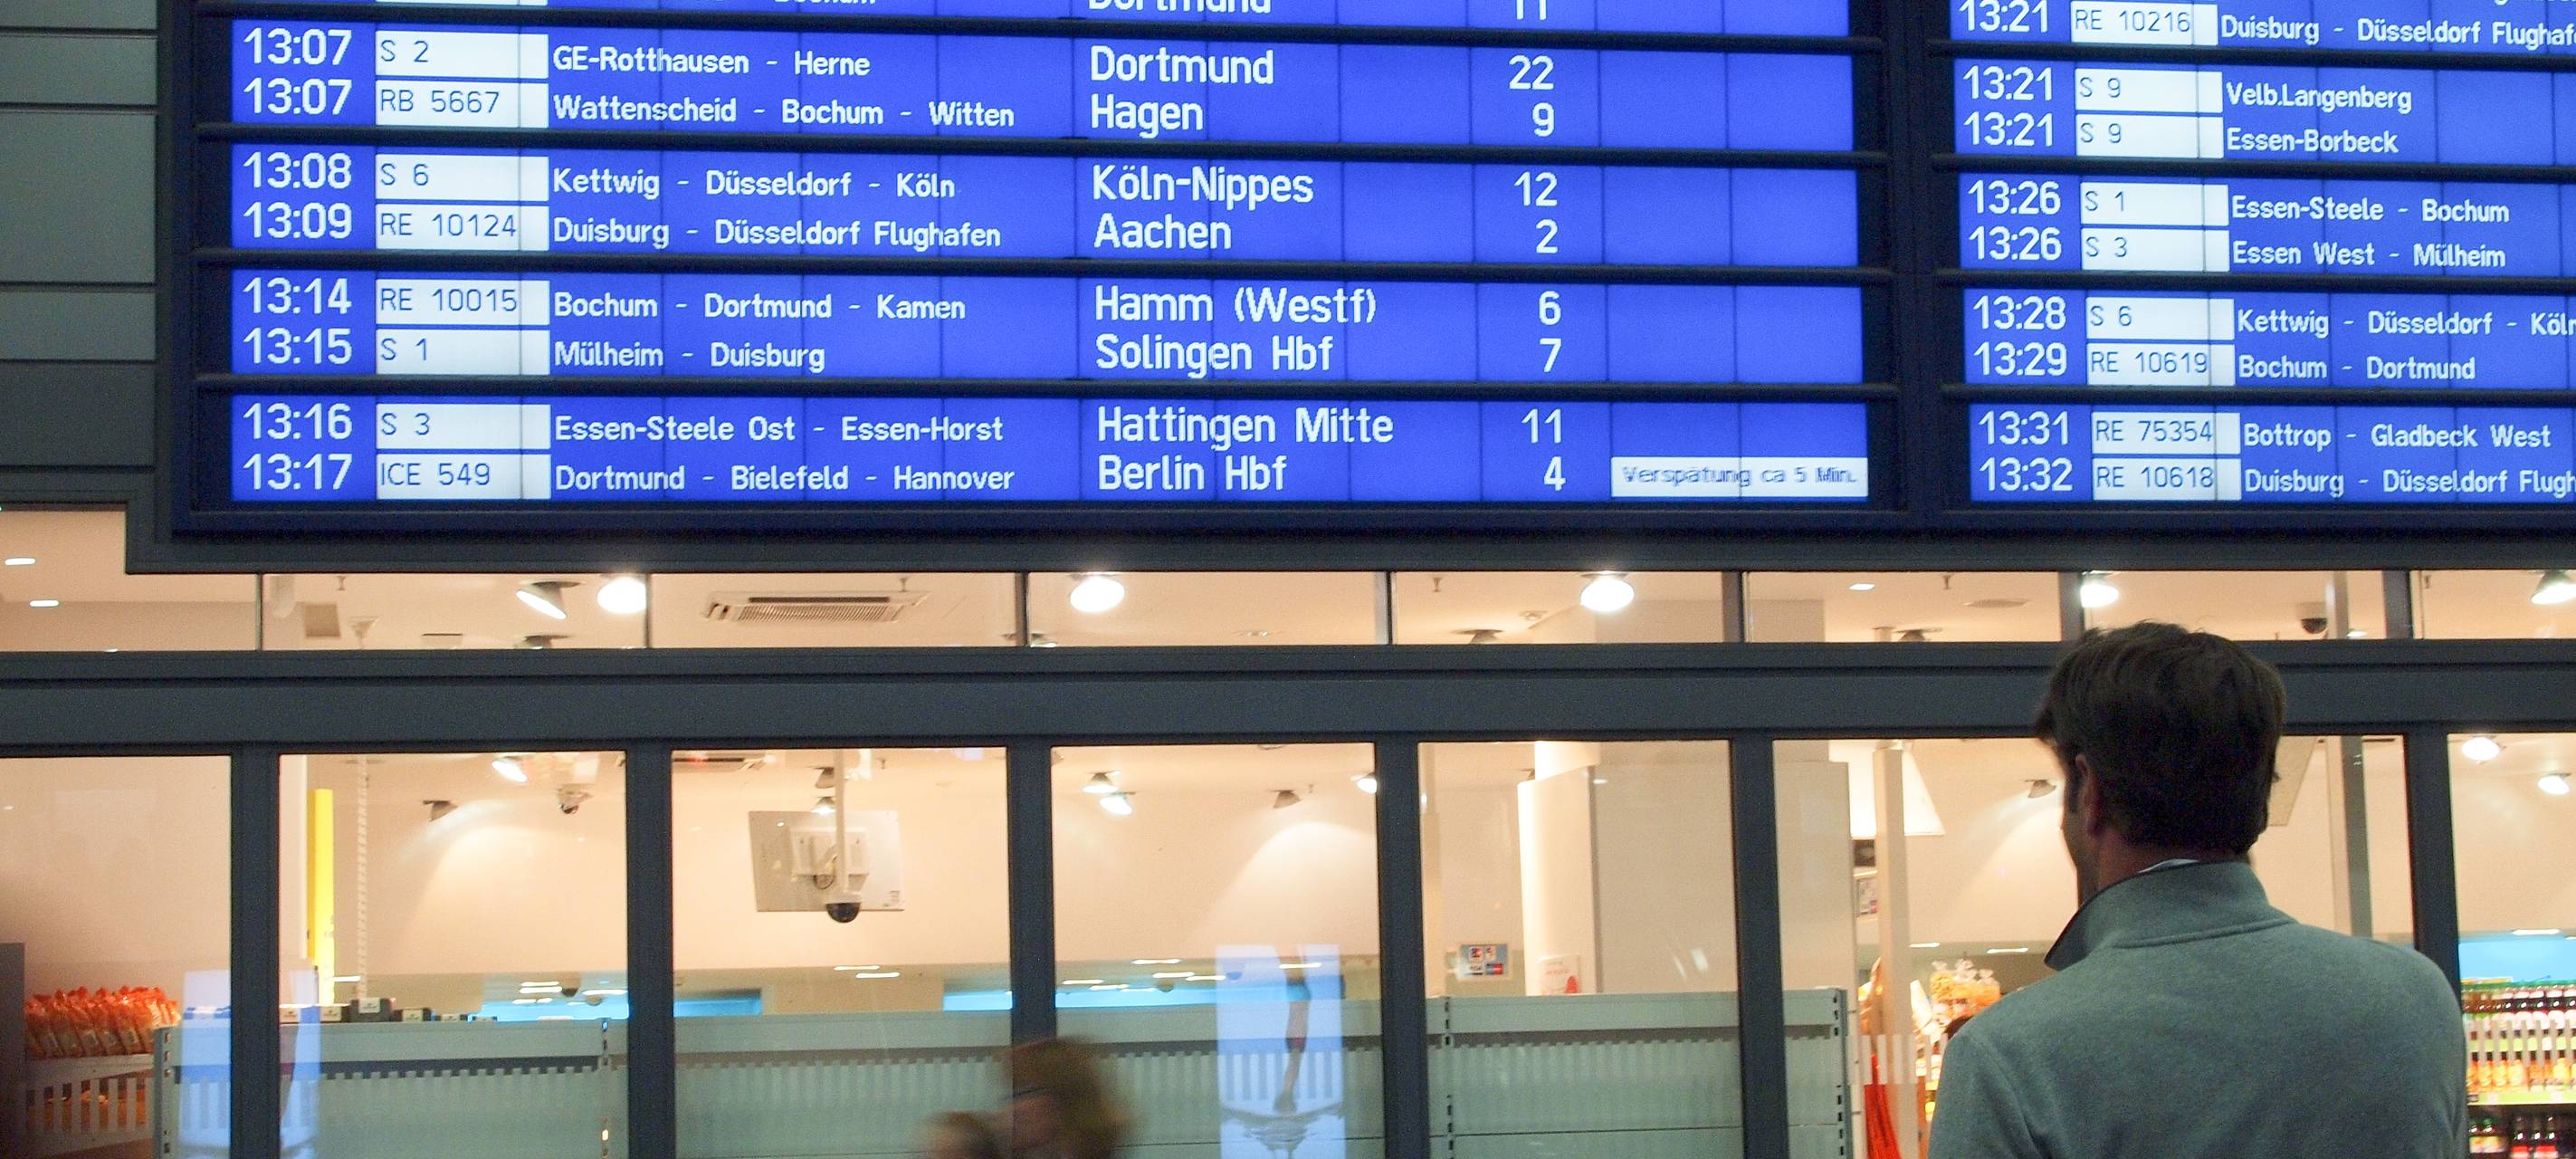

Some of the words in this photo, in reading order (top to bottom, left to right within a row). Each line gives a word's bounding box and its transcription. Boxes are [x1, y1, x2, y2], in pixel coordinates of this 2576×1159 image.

[1960, 0, 2047, 32] 13:21
[2076, 9, 2102, 30] RE
[2120, 11, 2190, 32] 10216
[2222, 14, 2319, 44] Duisburg
[2358, 18, 2480, 43] Düsseldorf
[2493, 22, 2576, 50] Flughaf
[244, 28, 351, 64] 13:07
[381, 40, 395, 62] S
[414, 41, 428, 62] 2
[554, 46, 749, 73] GE-Rotthausen
[796, 51, 870, 75] Herne
[1092, 46, 1273, 83] Dortmund
[1510, 55, 1553, 90] 22
[244, 78, 351, 114] 13:07
[1963, 66, 2051, 101] 13:21
[2080, 77, 2093, 97] S
[2108, 78, 2121, 98] 9
[2227, 82, 2411, 114] Velb.Langenberg
[381, 89, 413, 111] RB
[432, 91, 499, 113] 5667
[554, 95, 736, 121] Wattenscheid
[783, 99, 883, 124] Bochum
[929, 101, 1014, 126] Witten
[1092, 94, 1202, 139] Hagen
[1533, 103, 1554, 136] 9
[1964, 111, 2052, 146] 13:21
[2081, 123, 2093, 143] S
[2109, 123, 2121, 143] 9
[2228, 128, 2399, 152] Essen-Borbeck
[244, 152, 351, 188] 13:08
[381, 163, 396, 186] S
[414, 164, 428, 186] 6
[554, 168, 659, 199] Kettwig
[707, 170, 851, 196] Düsseldorf
[898, 173, 954, 197] Köln
[1093, 165, 1313, 210] Köln-Nippes
[1515, 172, 1557, 206] 12
[1969, 180, 2060, 214] 13:26
[2085, 191, 2098, 211] S
[2115, 191, 2123, 211] 1
[243, 202, 351, 238] 13:09
[381, 213, 412, 235] RE
[433, 214, 516, 236] 10124
[2233, 196, 2383, 220] Essen-Steele
[2423, 199, 2509, 222] Bochum
[554, 217, 669, 248] Duisburg
[716, 219, 860, 244] Düsseldorf
[875, 221, 1000, 252] Flughafen
[1094, 214, 1231, 248] Aachen
[1536, 219, 1558, 253] 2
[1970, 226, 2061, 260] 13:26
[2086, 236, 2099, 257] S
[2114, 237, 2126, 257] 3
[2234, 241, 2301, 263] Essen
[2314, 242, 2374, 264] West
[2414, 244, 2505, 266] Mülheim
[243, 278, 351, 313] 13:14
[380, 288, 413, 311] RE
[433, 289, 517, 311] 10015
[555, 292, 657, 316] Bochum
[705, 293, 831, 318] Dortmund
[878, 294, 965, 319] Kamen
[1096, 285, 1212, 321] Hamm
[1235, 287, 1376, 322] (Westf)
[1540, 292, 1560, 325] 6
[1974, 296, 2066, 330] 13:28
[2091, 305, 2104, 326] S
[2119, 306, 2132, 326] 6
[2238, 310, 2328, 338] Kettwig
[2369, 311, 2492, 334] Düsseldorf
[243, 328, 351, 363] 13:15
[381, 338, 396, 360] S
[416, 339, 426, 360] 1
[555, 341, 663, 366] Mülheim
[711, 342, 825, 373] Duisburg
[1096, 334, 1252, 378] Solingen
[1273, 336, 1332, 370] Hbf
[1541, 339, 1560, 372] 7
[1974, 342, 2066, 375] 13:29
[2092, 351, 2119, 372] RE
[2136, 352, 2208, 373] 10619
[2239, 355, 2326, 378] Bochum
[2367, 357, 2475, 378] Dortmund
[244, 404, 351, 439] 13:16
[381, 413, 396, 435] S
[415, 413, 430, 436] 3
[556, 416, 733, 440] Essen-Steele
[749, 417, 795, 440] Ost
[843, 417, 1003, 440] Essen-Horst
[1099, 407, 1275, 451] Hattingen
[1296, 407, 1393, 442] Mitte
[1522, 409, 1560, 443] 11
[1980, 411, 2067, 445] 13:31
[2096, 420, 2123, 441] RE
[2138, 420, 2213, 442] 75354
[2245, 424, 2331, 451] Bottrop
[2371, 425, 2477, 446] Gladbeck
[2491, 425, 2550, 446] West
[243, 454, 351, 489] 13:17
[381, 463, 421, 485] ICE
[438, 463, 490, 485] 549
[557, 465, 684, 489] Dortmund
[732, 465, 848, 489] Bielefeld
[894, 465, 1015, 489] Hannover
[1100, 455, 1204, 489] Berlin
[1226, 455, 1286, 490] Hbf
[1544, 456, 1565, 490] 4
[1761, 469, 1786, 483] ca
[1795, 466, 1807, 483] 5
[1816, 466, 1857, 483] Min.
[1980, 457, 2072, 491] 13:32
[2096, 466, 2124, 487] RE
[2142, 466, 2214, 487] 10618
[2246, 469, 2343, 497] Duisburg
[2384, 470, 2507, 492] Düsseldorf
